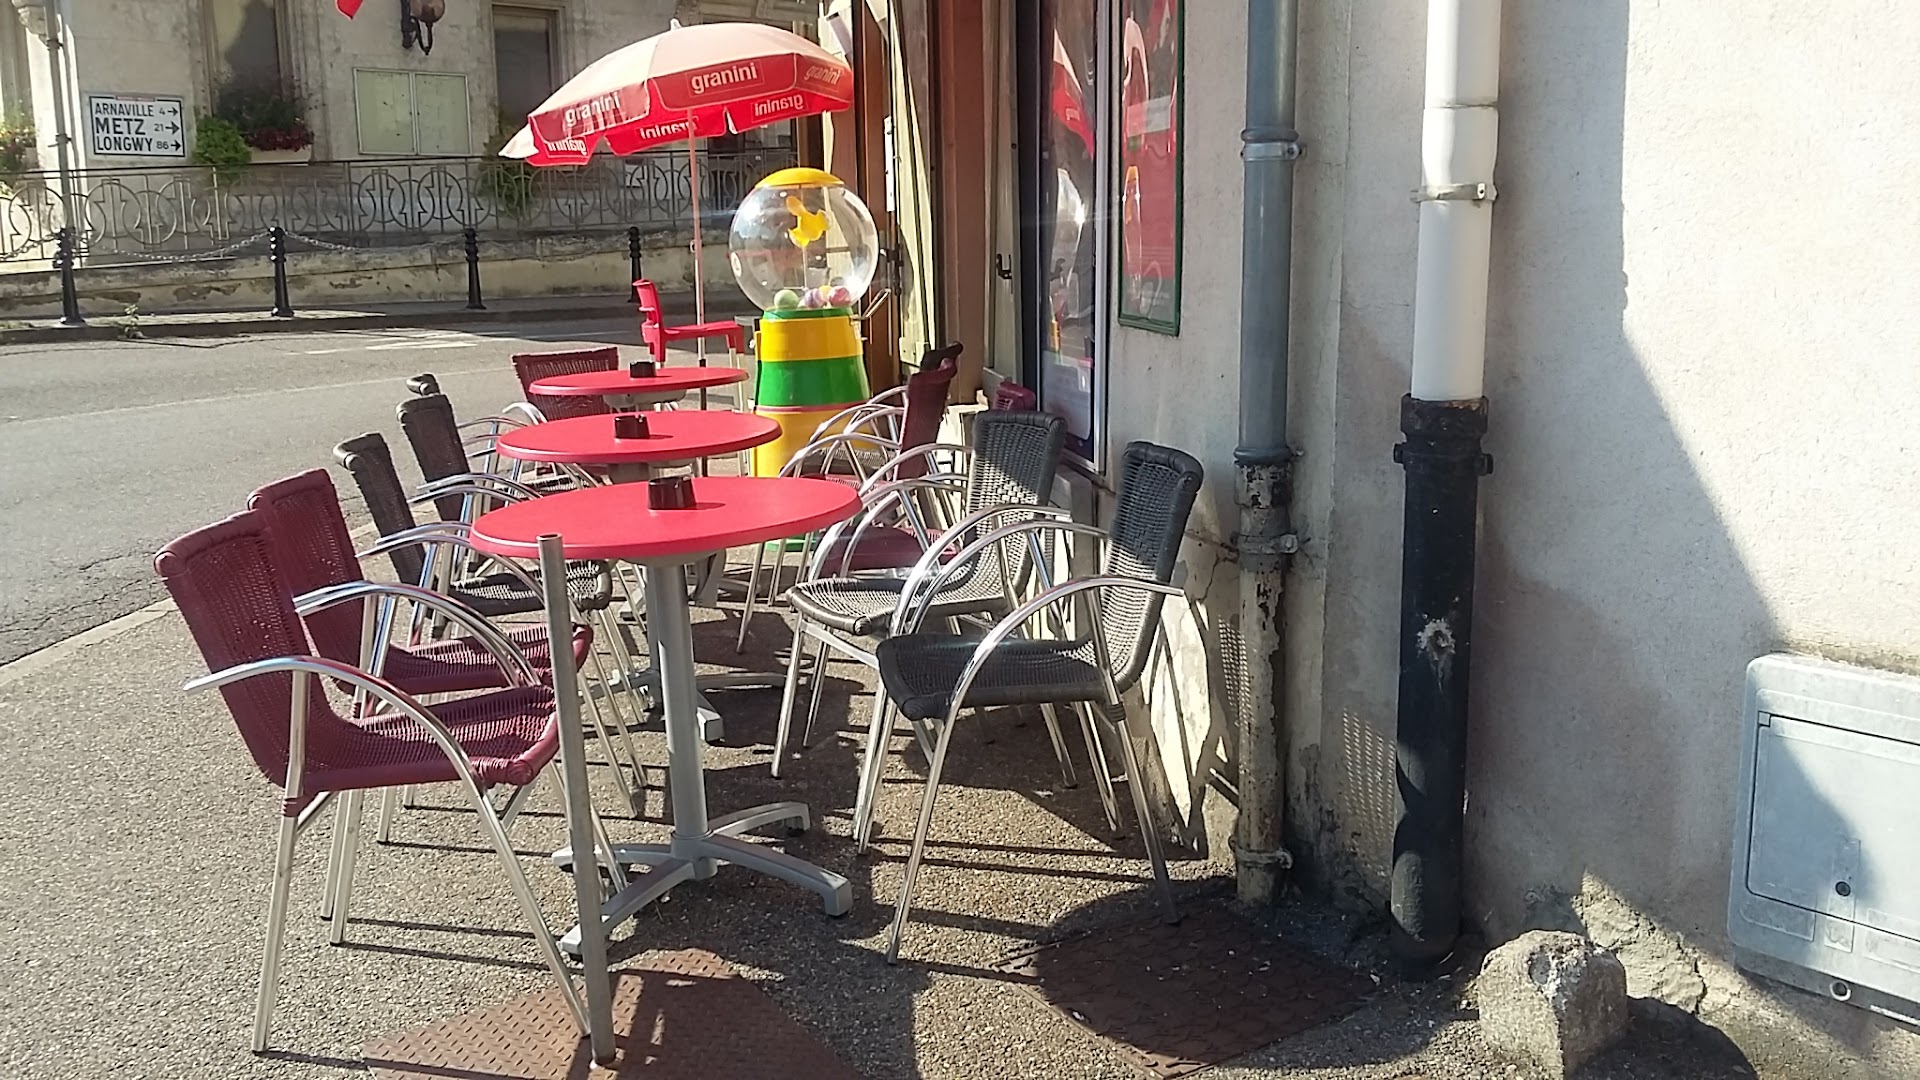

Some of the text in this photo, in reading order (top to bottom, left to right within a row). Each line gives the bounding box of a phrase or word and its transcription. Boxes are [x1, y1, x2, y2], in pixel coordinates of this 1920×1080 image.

[692, 62, 758, 94] granini
[804, 65, 841, 85] granini
[95, 102, 166, 117] ARNAVILLE 4
[564, 91, 621, 127] granini
[95, 116, 164, 135] METZ 21
[97, 136, 169, 152] LONGWY 86
